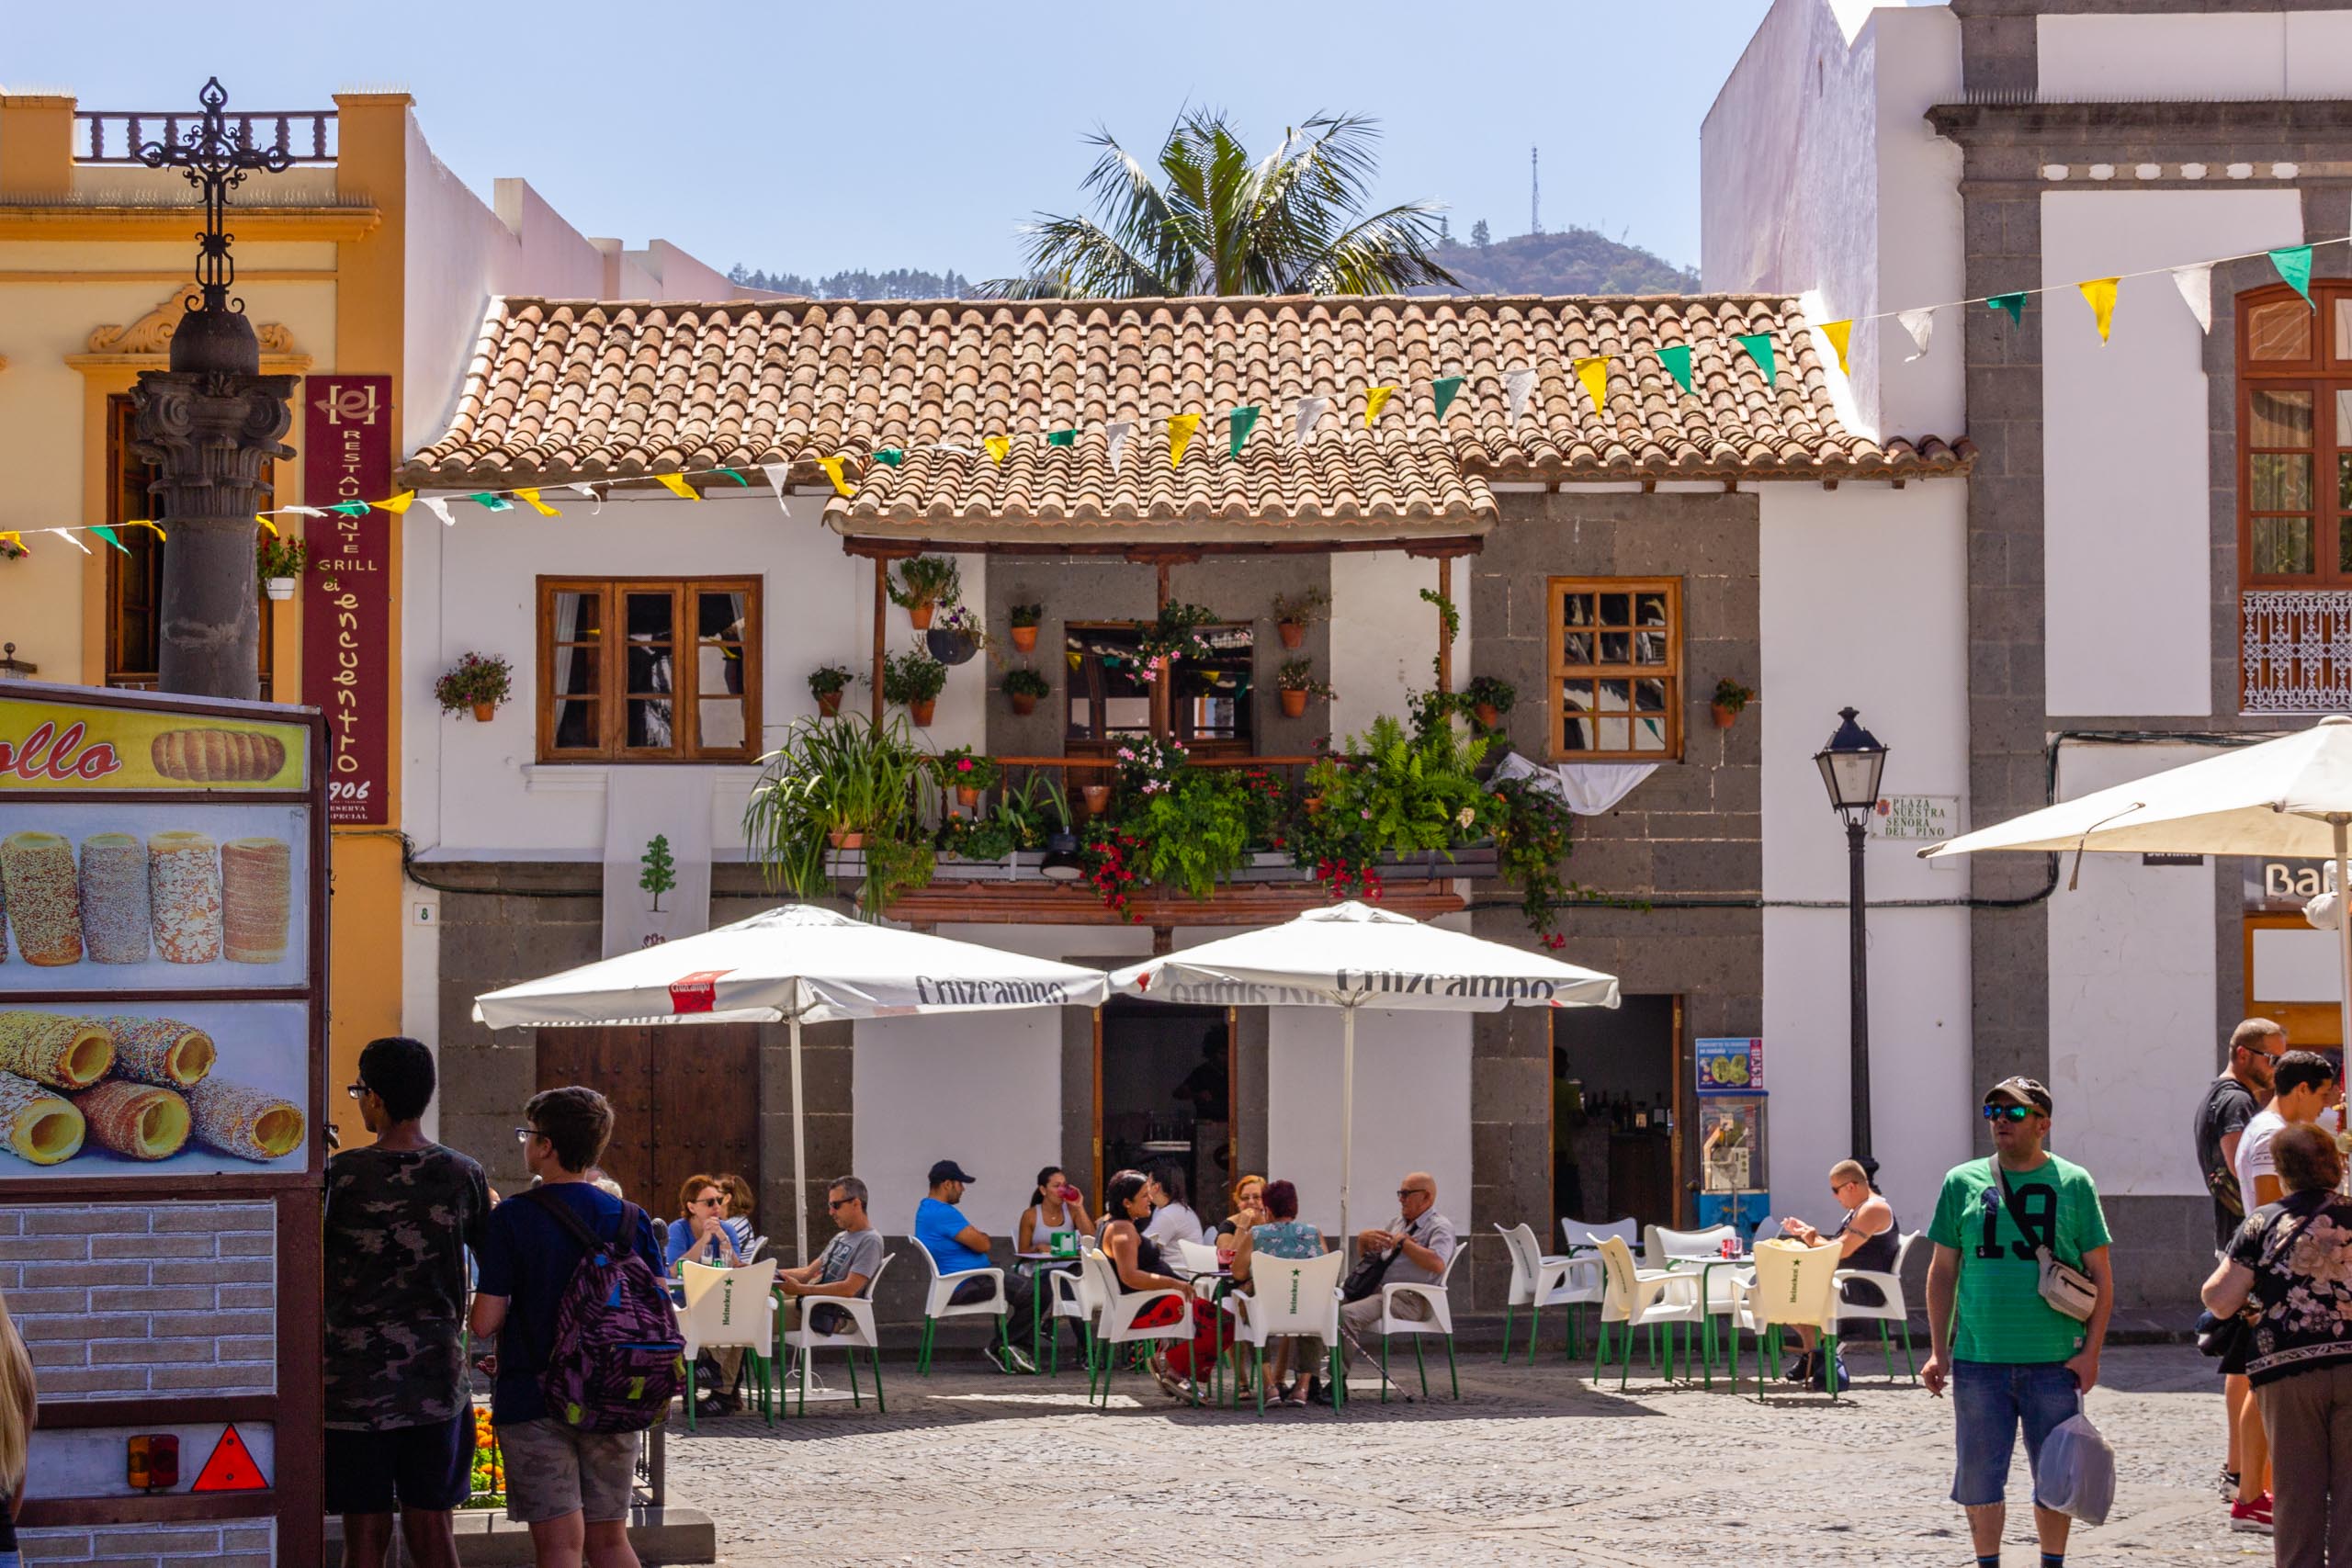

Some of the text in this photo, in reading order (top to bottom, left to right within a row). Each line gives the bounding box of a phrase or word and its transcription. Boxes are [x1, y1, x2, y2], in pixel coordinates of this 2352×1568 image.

[337, 430, 362, 554] RESTAUANTE
[317, 559, 378, 570] GRILL
[1893, 798, 1930, 808] PLAZA
[1893, 807, 1945, 818] NUESTRA
[1885, 827, 1945, 837] DEL PINO
[421, 907, 429, 920] 8
[1975, 1182, 2057, 1261] 19
[722, 1288, 731, 1325] Heineken
